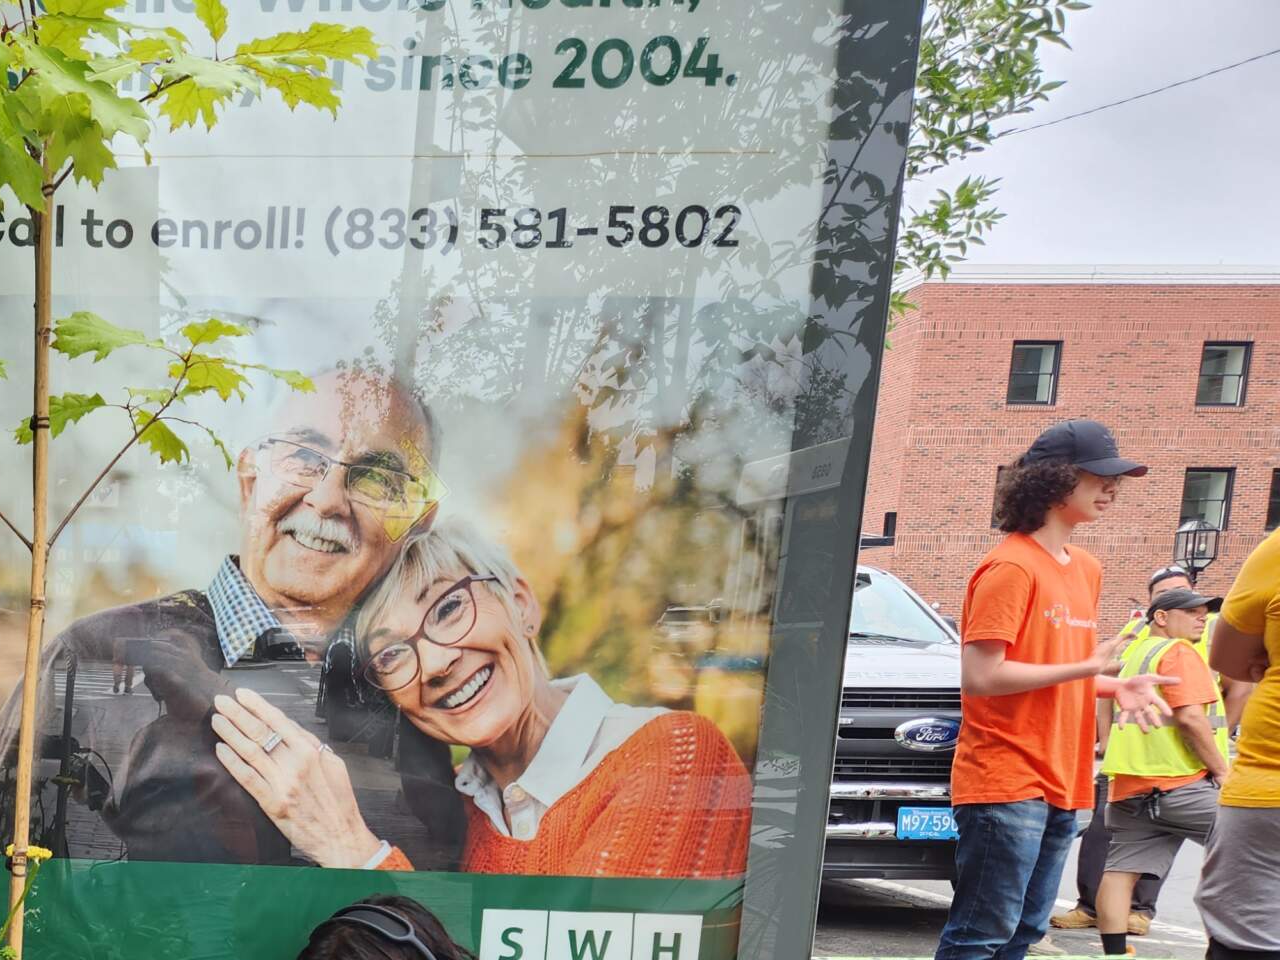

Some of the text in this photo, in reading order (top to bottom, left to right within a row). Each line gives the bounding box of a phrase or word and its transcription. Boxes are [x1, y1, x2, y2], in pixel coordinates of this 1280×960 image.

[364, 37, 533, 91] since
[552, 35, 738, 90] 2004.
[81, 208, 134, 249] to
[151, 205, 306, 251] enroll!
[325, 206, 459, 257] (833)
[479, 204, 743, 250] 581-5802
[915, 726, 950, 741] Ford
